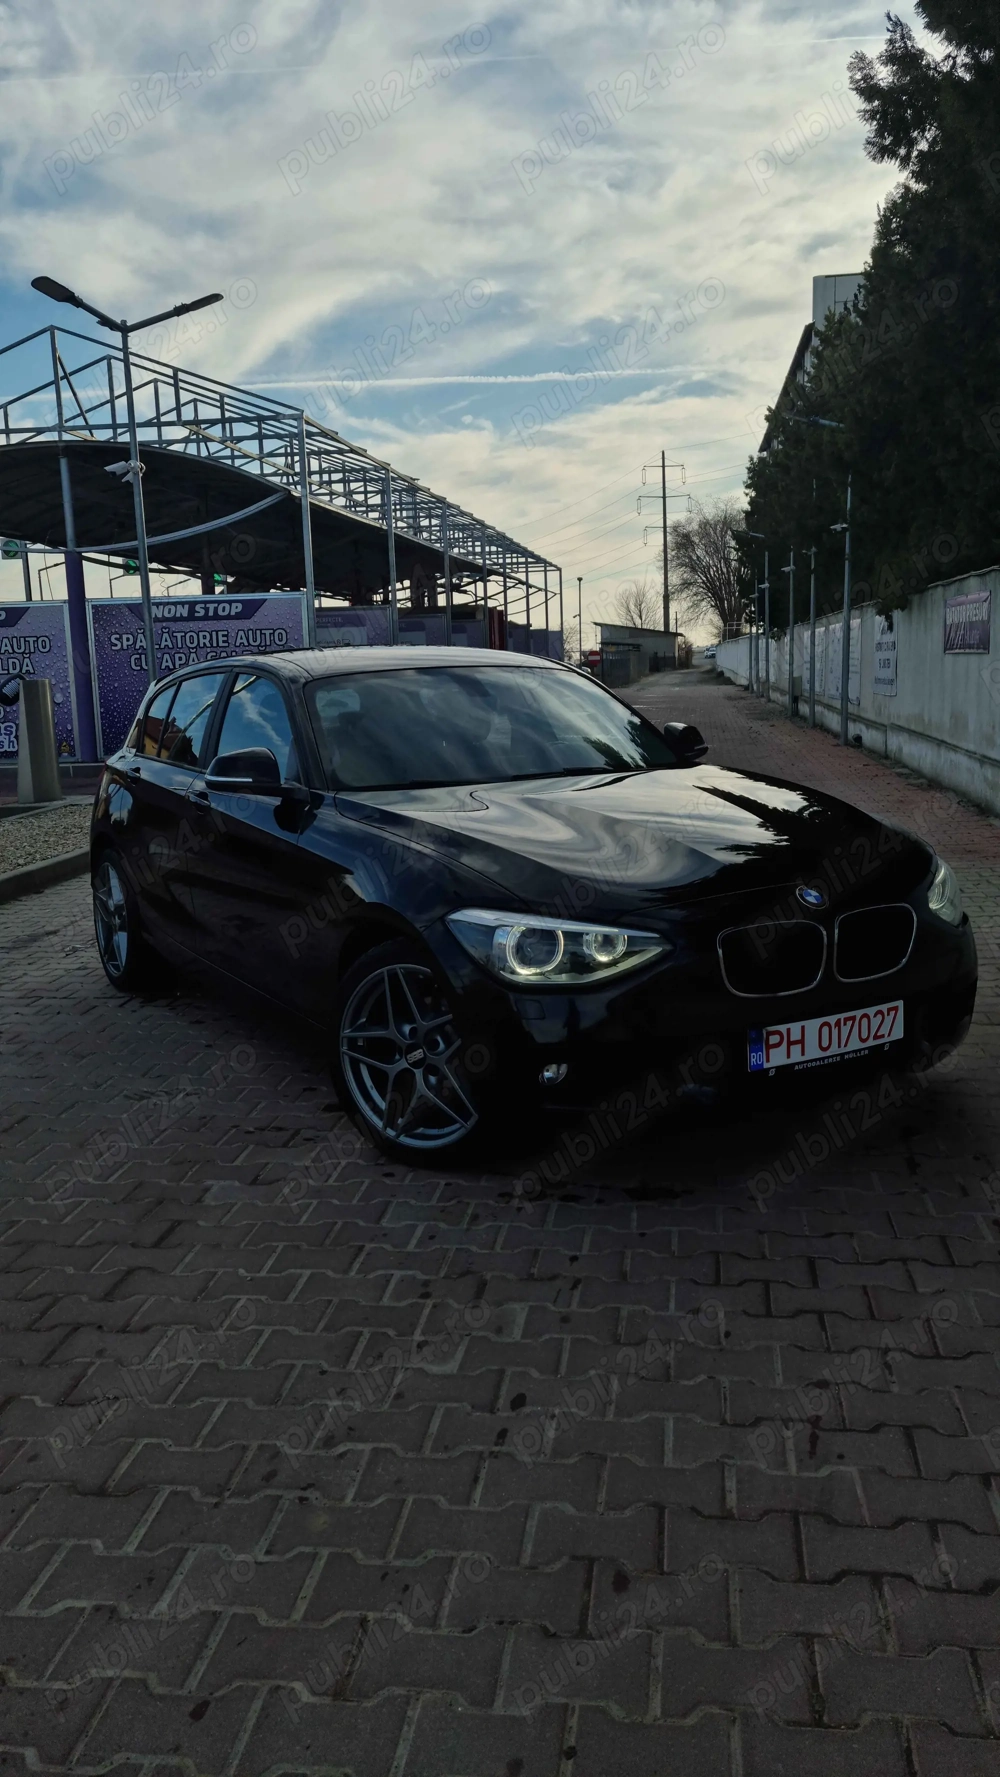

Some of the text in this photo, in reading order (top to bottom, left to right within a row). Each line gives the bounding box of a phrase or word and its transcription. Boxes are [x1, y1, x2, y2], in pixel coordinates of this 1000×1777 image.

[152, 603, 243, 617] NON STOP
[0, 636, 51, 654] AUTO
[110, 628, 287, 650] SPĂĂTORIE AUTO
[161, 648, 199, 670] APĂ
[750, 1005, 899, 1066] RO PH 017027
